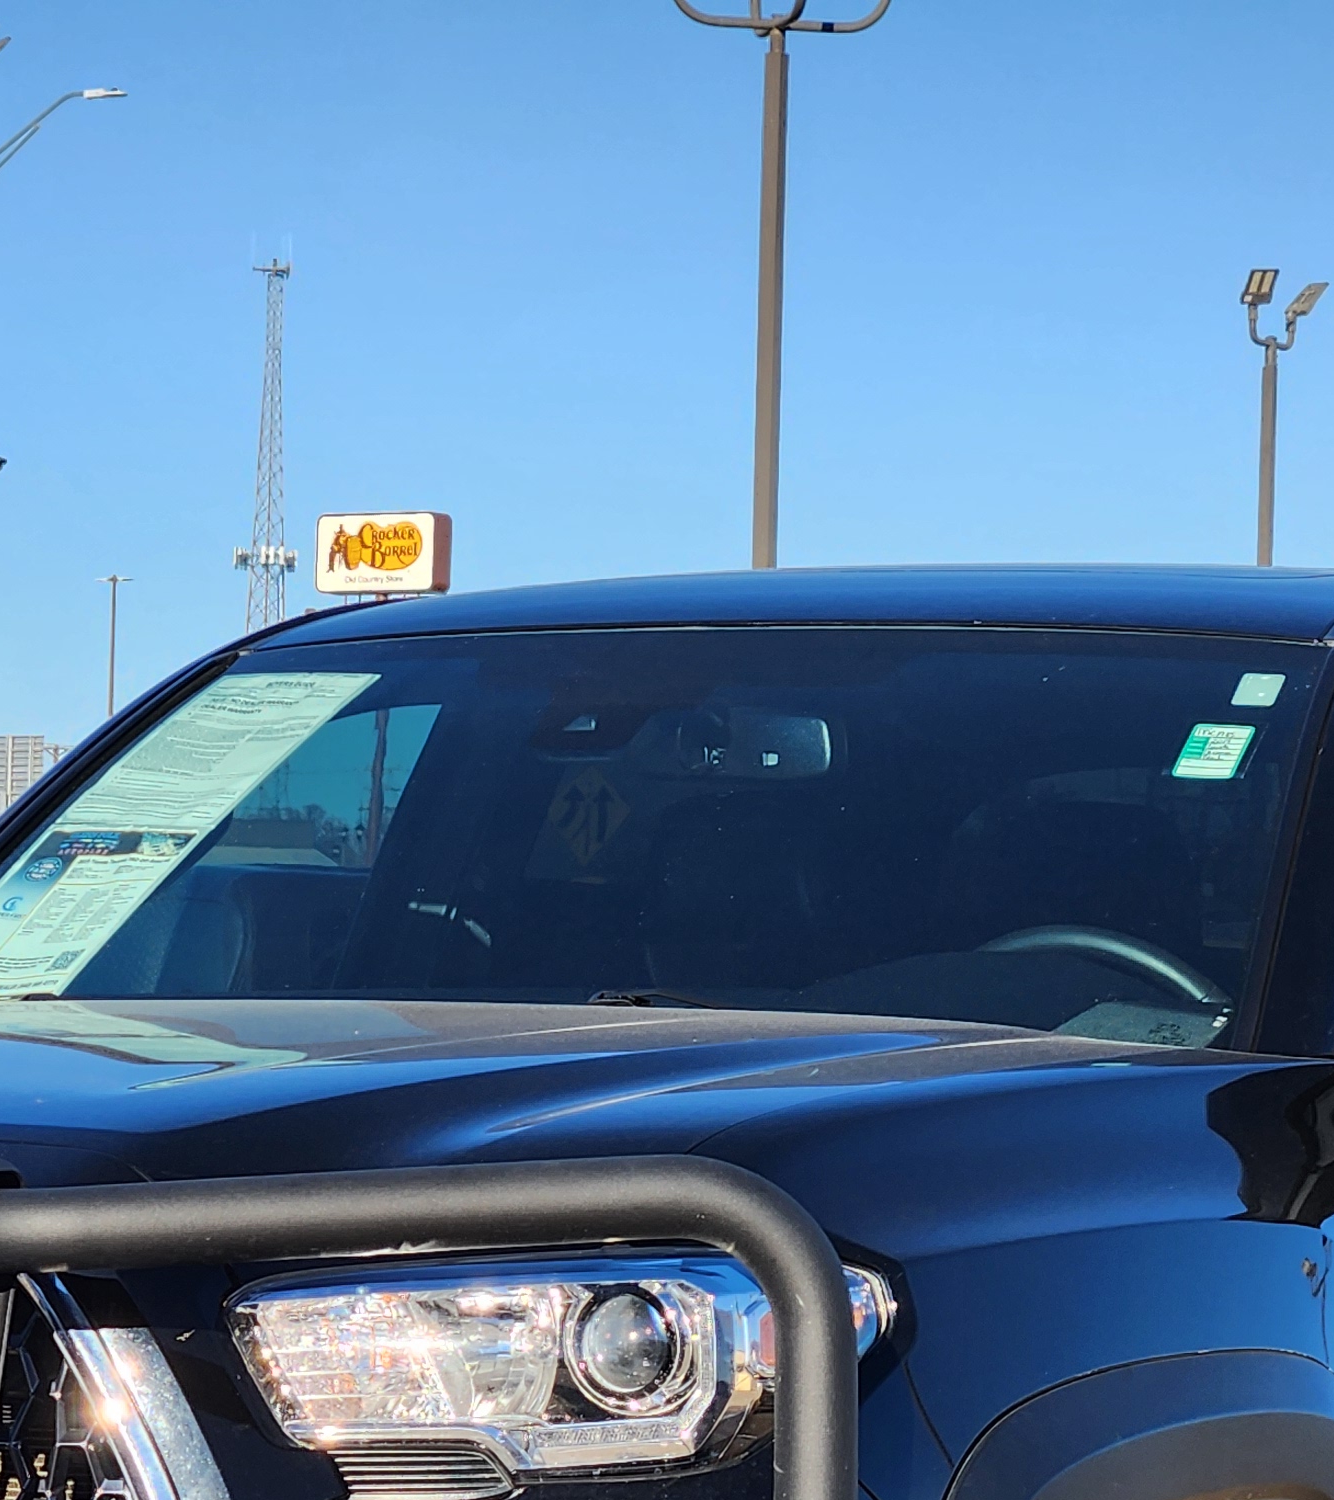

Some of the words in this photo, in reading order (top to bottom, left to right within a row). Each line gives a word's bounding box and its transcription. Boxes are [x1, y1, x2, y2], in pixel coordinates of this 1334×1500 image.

[359, 523, 416, 548] Cracker
[371, 541, 418, 568] Barrel
[345, 576, 356, 584] Old
[358, 575, 384, 585] Country
[386, 574, 404, 583] Store
